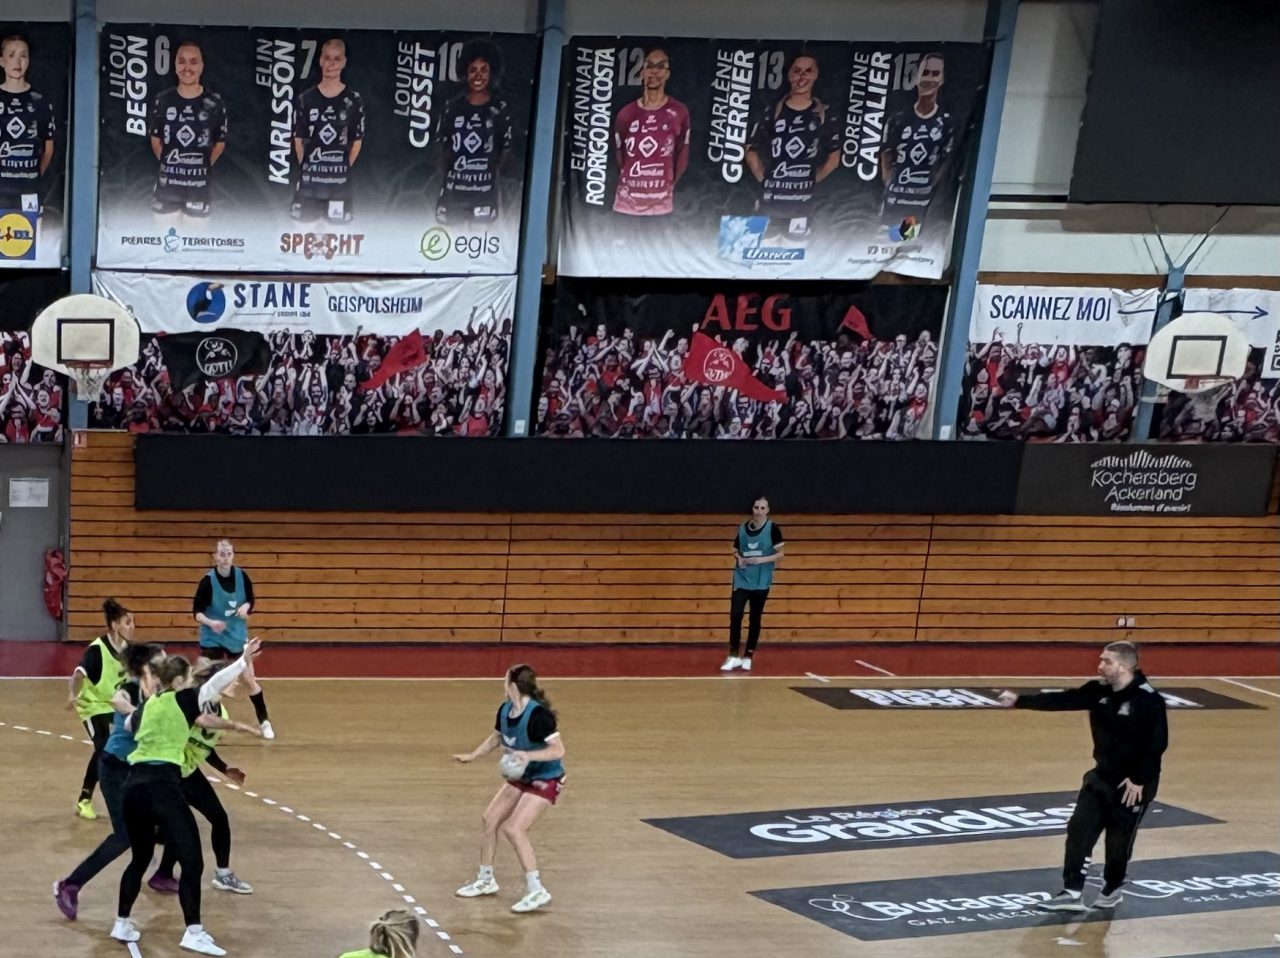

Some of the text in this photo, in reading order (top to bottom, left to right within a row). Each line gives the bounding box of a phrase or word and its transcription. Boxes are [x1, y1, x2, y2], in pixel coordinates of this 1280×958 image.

[109, 34, 126, 99] LILOU
[154, 35, 170, 75] 6
[256, 38, 273, 87] ELIN
[299, 40, 317, 79] 7
[618, 48, 644, 87] 12
[758, 51, 784, 90] 13
[892, 53, 921, 91] 15
[126, 35, 148, 137] BEGON
[394, 41, 414, 117] LOUISE
[409, 42, 435, 148] CUSSET
[268, 39, 296, 185] KARLSSON
[571, 47, 593, 171] ELIHANNAH
[586, 48, 616, 205] RODRIGO DA COSTA
[722, 50, 755, 183] GUERRIER
[842, 51, 870, 168] CORENTINE
[857, 51, 892, 181] CAVALIER
[454, 231, 500, 258] egis
[234, 283, 423, 314] STANE GEISPOLSHEIM
[701, 293, 793, 332] AEG
[990, 295, 1111, 322] SCANNEZ MOI
[1091, 469, 1198, 491] Kochersberg
[1104, 486, 1184, 502] Ackerland
[750, 802, 1078, 843] GrandEs
